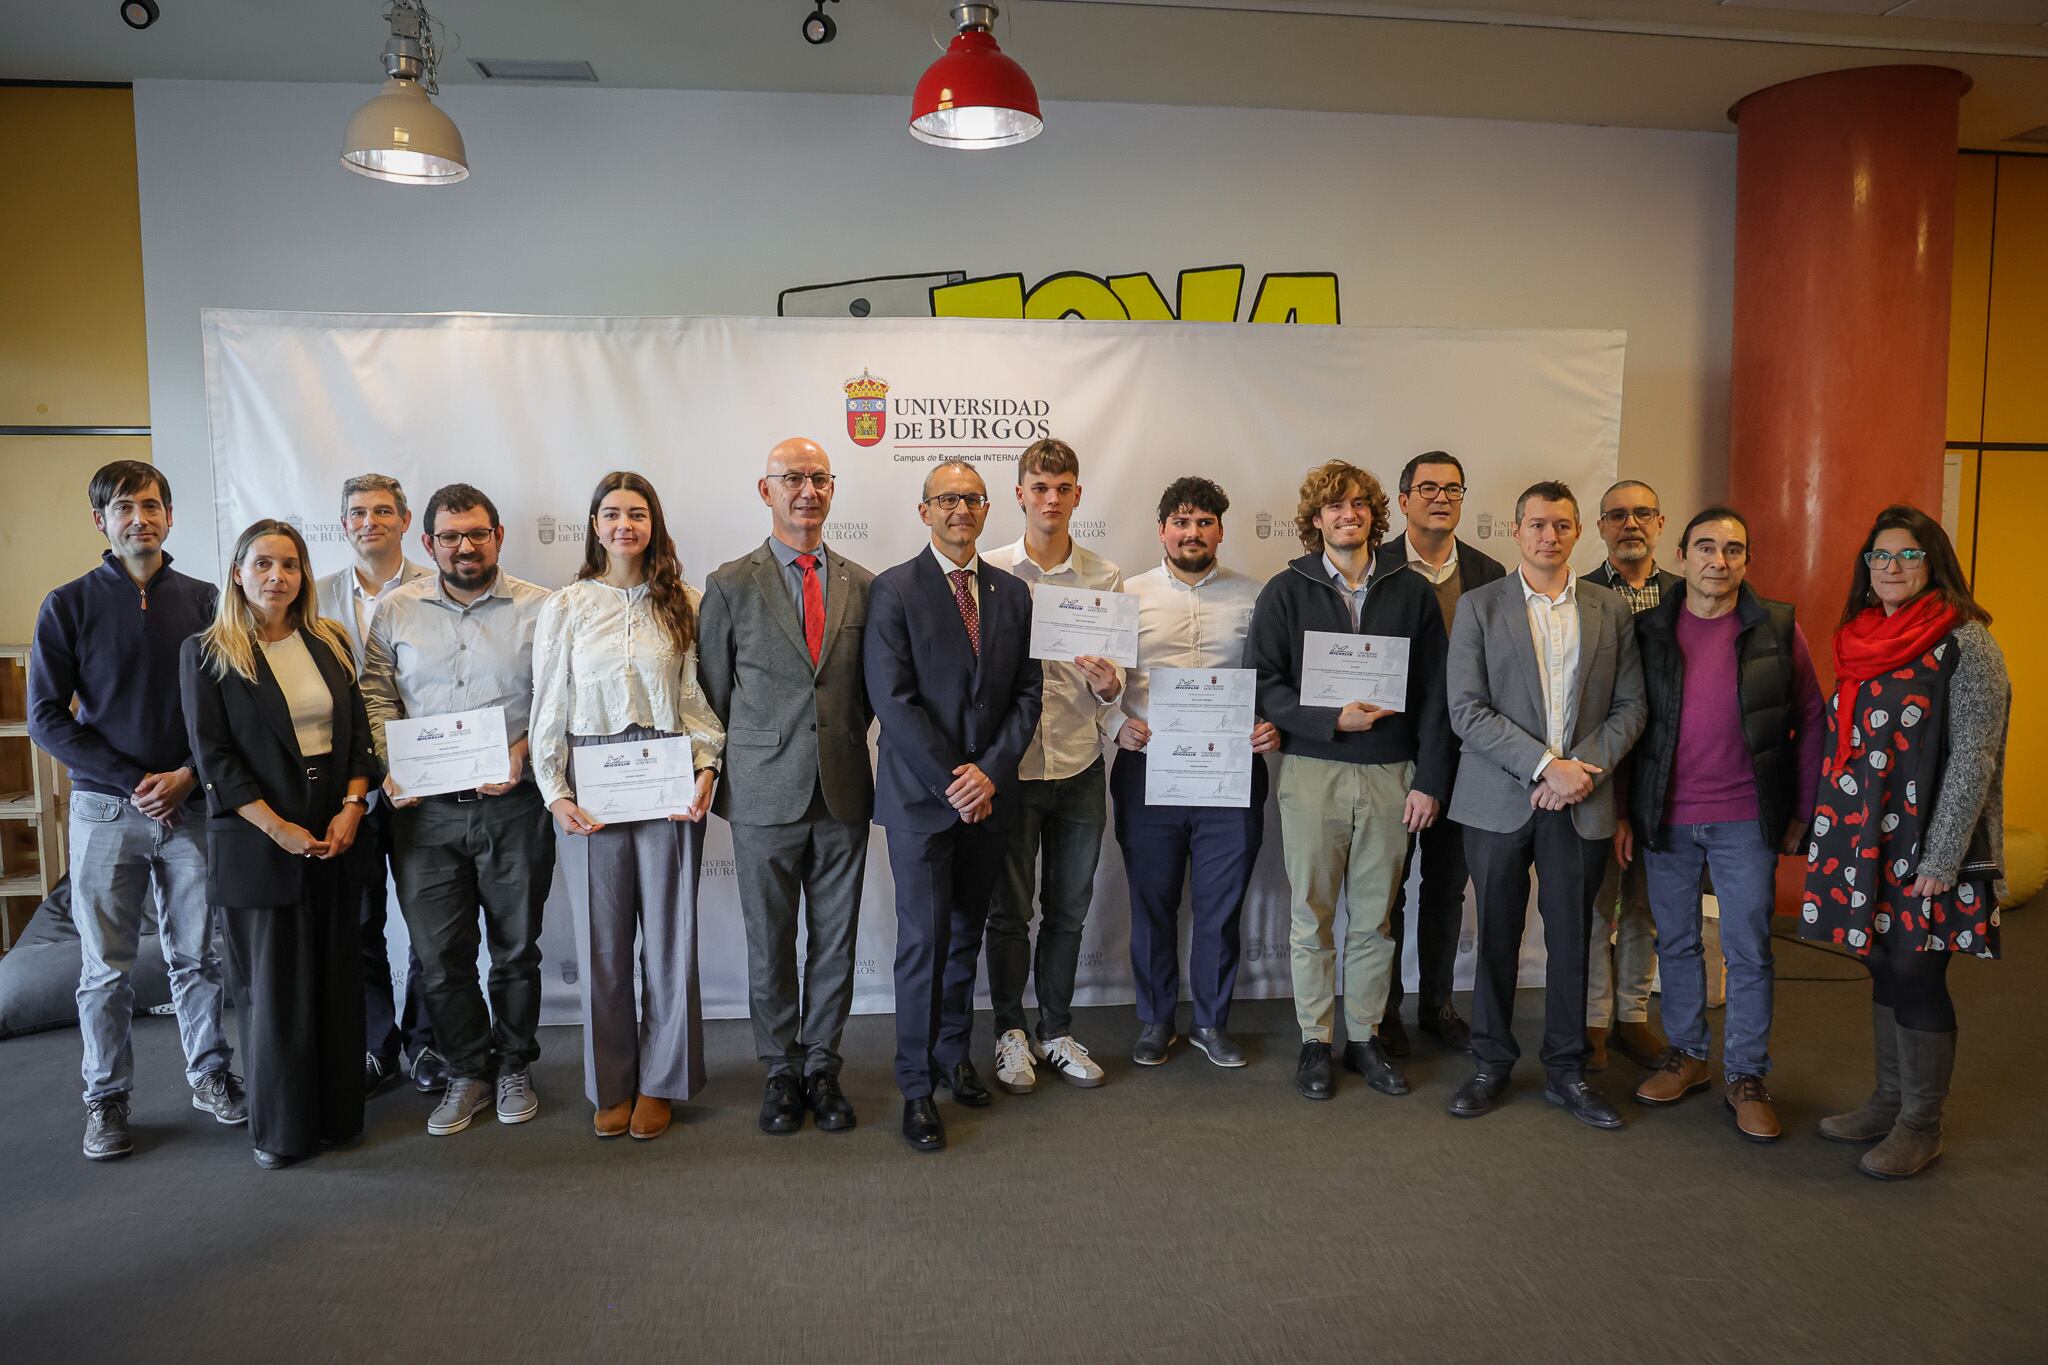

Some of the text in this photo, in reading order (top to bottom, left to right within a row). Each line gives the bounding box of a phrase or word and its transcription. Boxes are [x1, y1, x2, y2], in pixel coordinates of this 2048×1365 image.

[894, 398, 1050, 416] UNIVERSIDAD
[893, 418, 1050, 440] DE BURGOS
[893, 454, 925, 462] Campus
[927, 453, 937, 461] de
[938, 453, 982, 461] Excelencia
[305, 523, 343, 531] UNIVER
[305, 531, 346, 542] DE BUR
[558, 534, 571, 542] DE
[1072, 528, 1106, 538] RGOS
